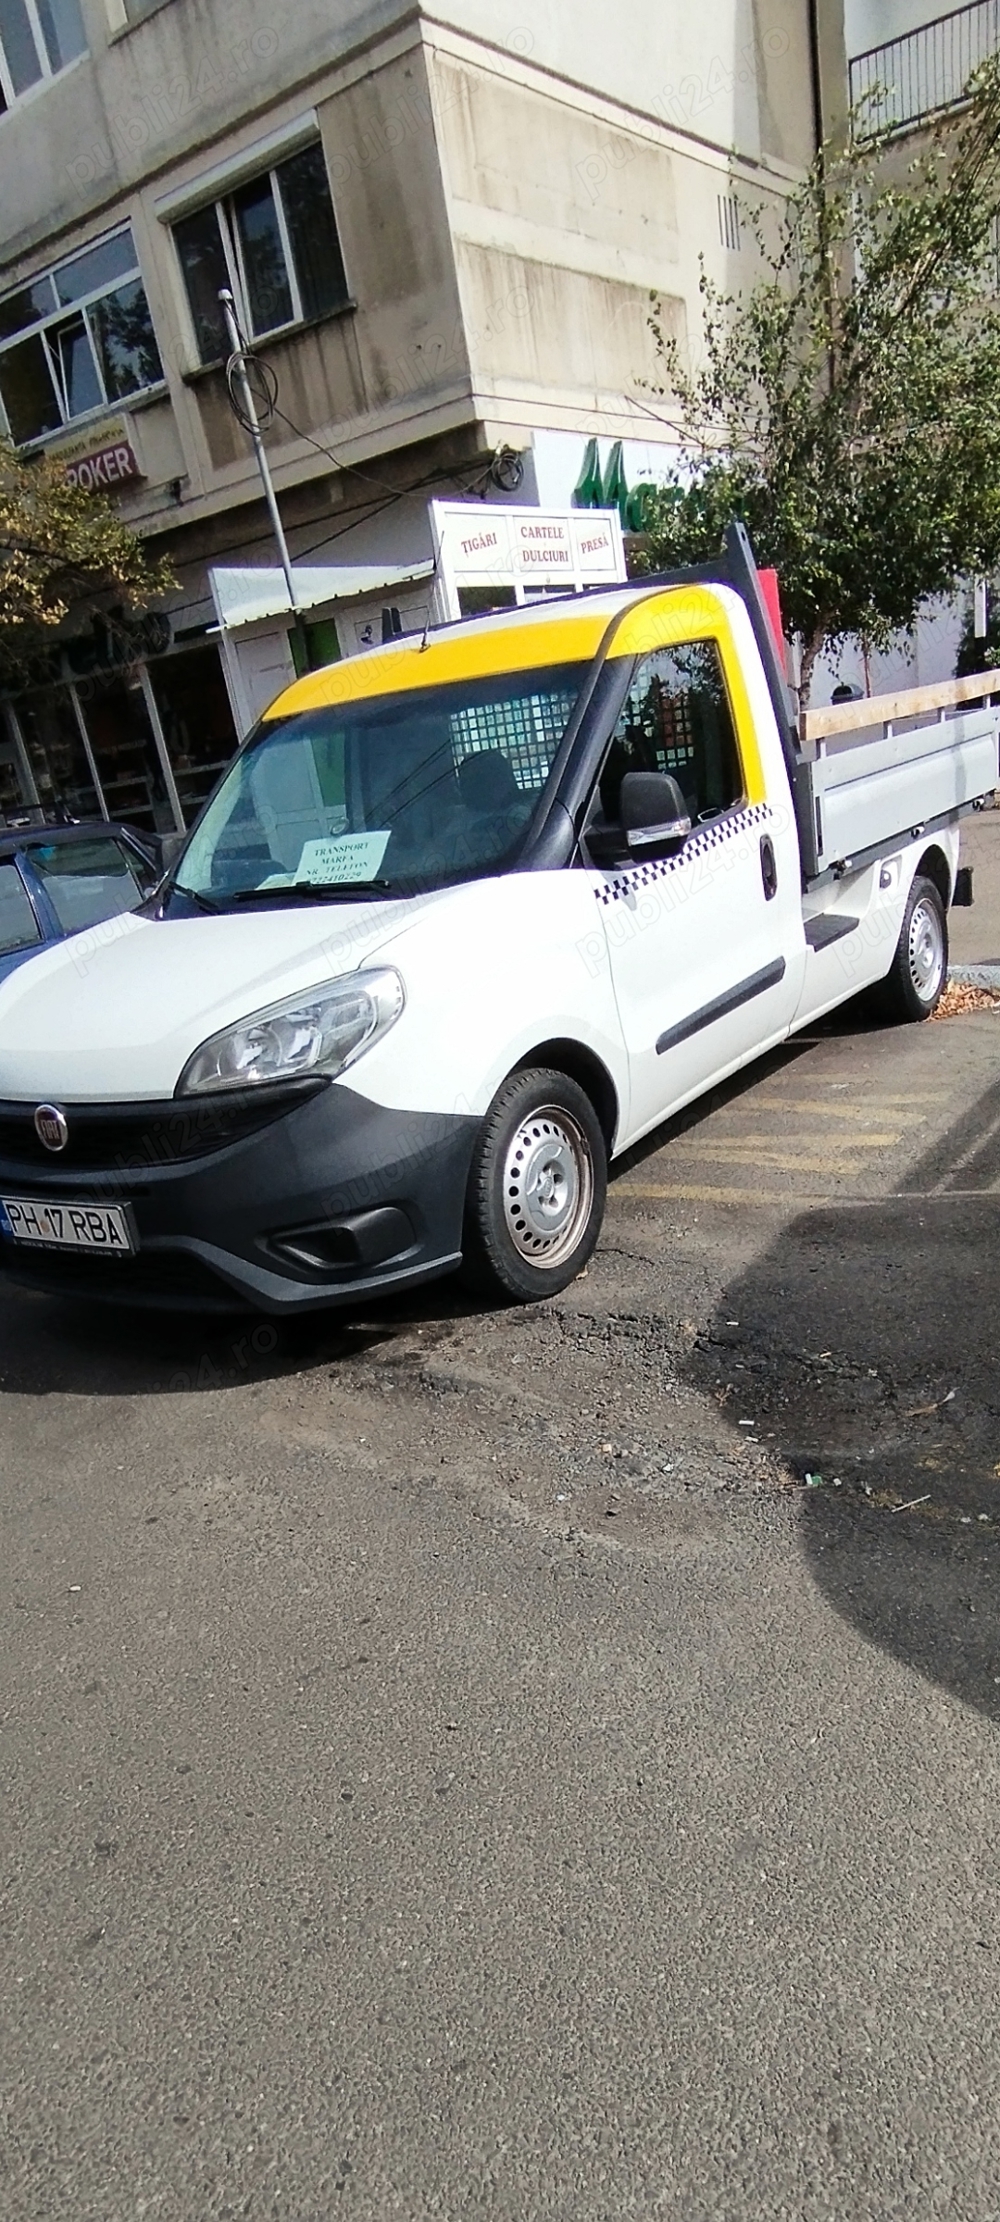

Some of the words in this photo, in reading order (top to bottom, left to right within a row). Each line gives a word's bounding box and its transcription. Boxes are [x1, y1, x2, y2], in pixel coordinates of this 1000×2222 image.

[66, 446, 134, 491] POKER
[520, 526, 565, 539] CARTELE
[522, 550, 569, 563] DULCIURI
[314, 842, 369, 856] TRANSPORT
[40, 1119, 60, 1139] FIAT
[6, 1204, 42, 1236] PH
[44, 1209, 64, 1239] 17
[68, 1211, 123, 1245] RBA
